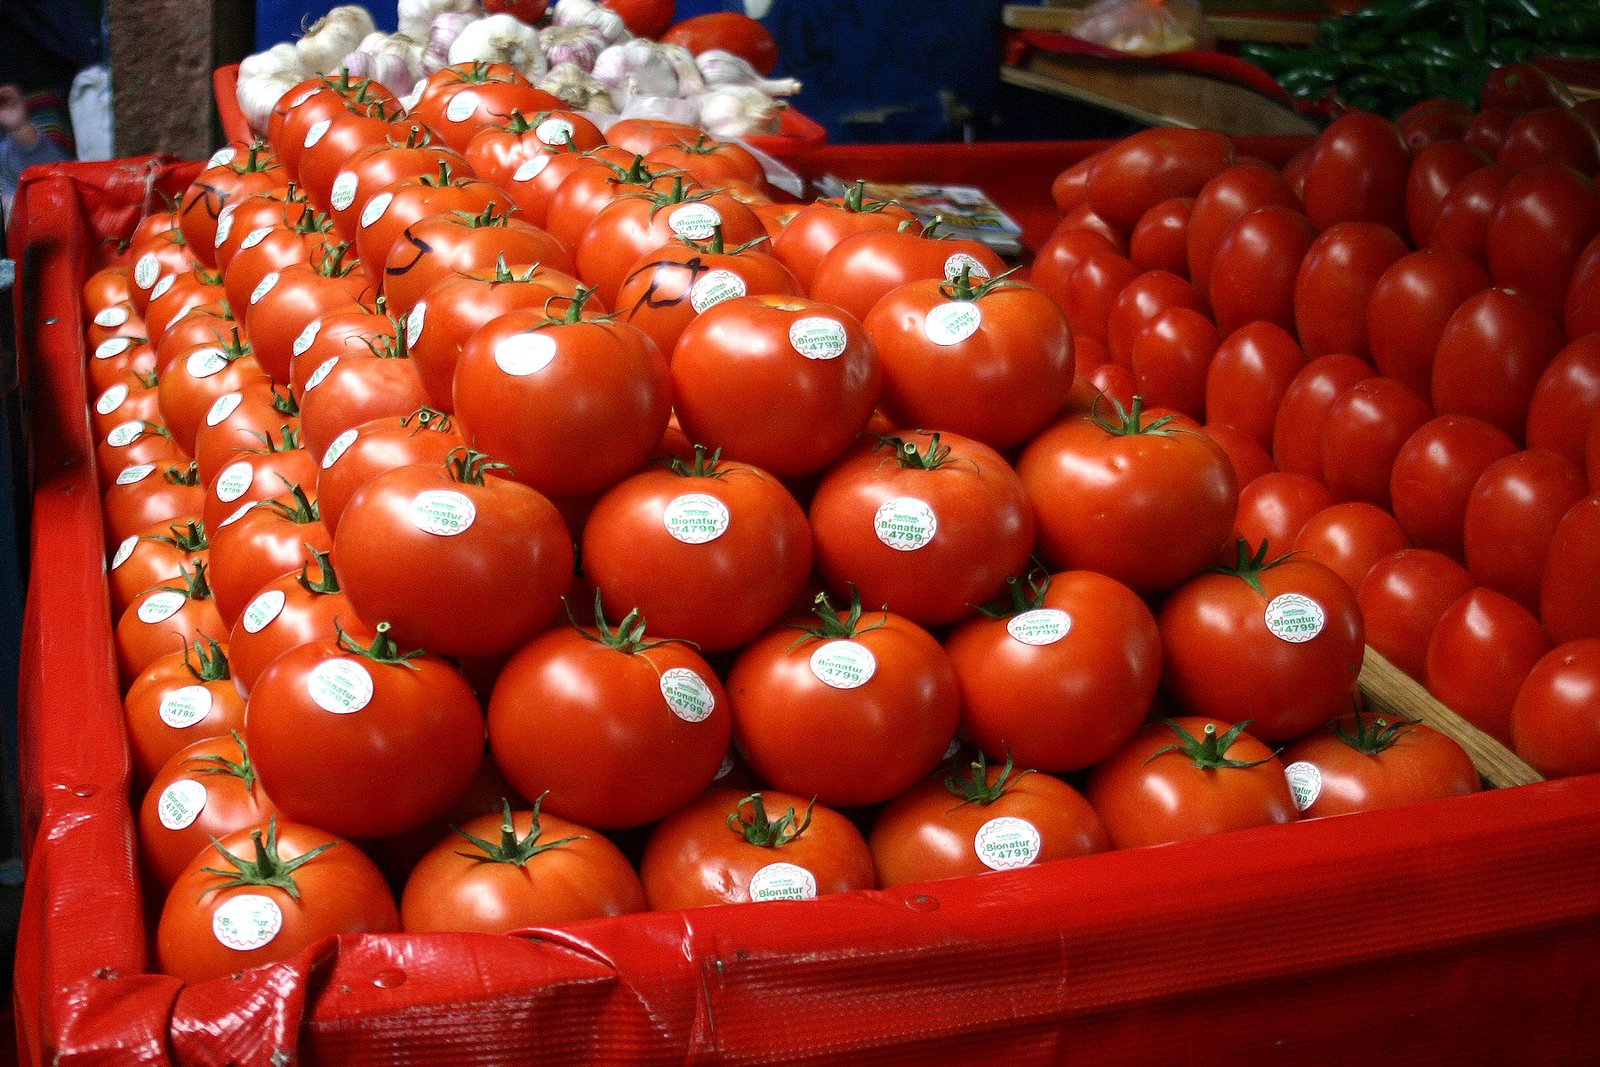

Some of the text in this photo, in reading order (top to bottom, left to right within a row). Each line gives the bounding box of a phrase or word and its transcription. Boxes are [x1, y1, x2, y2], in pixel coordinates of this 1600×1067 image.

[700, 286, 737, 309] Bionatur
[798, 336, 839, 345] Bionatur
[671, 515, 719, 526] Bionatur
[881, 519, 927, 533] Bionatur
[1015, 623, 1060, 632] Bionatur
[1273, 616, 1316, 627] Bionatur
[818, 658, 864, 674] Bionatur
[667, 686, 707, 708] Bionatur
[166, 790, 188, 815] Bionatur
[986, 840, 1031, 853] Bionatur
[758, 887, 804, 899] Bionatur
